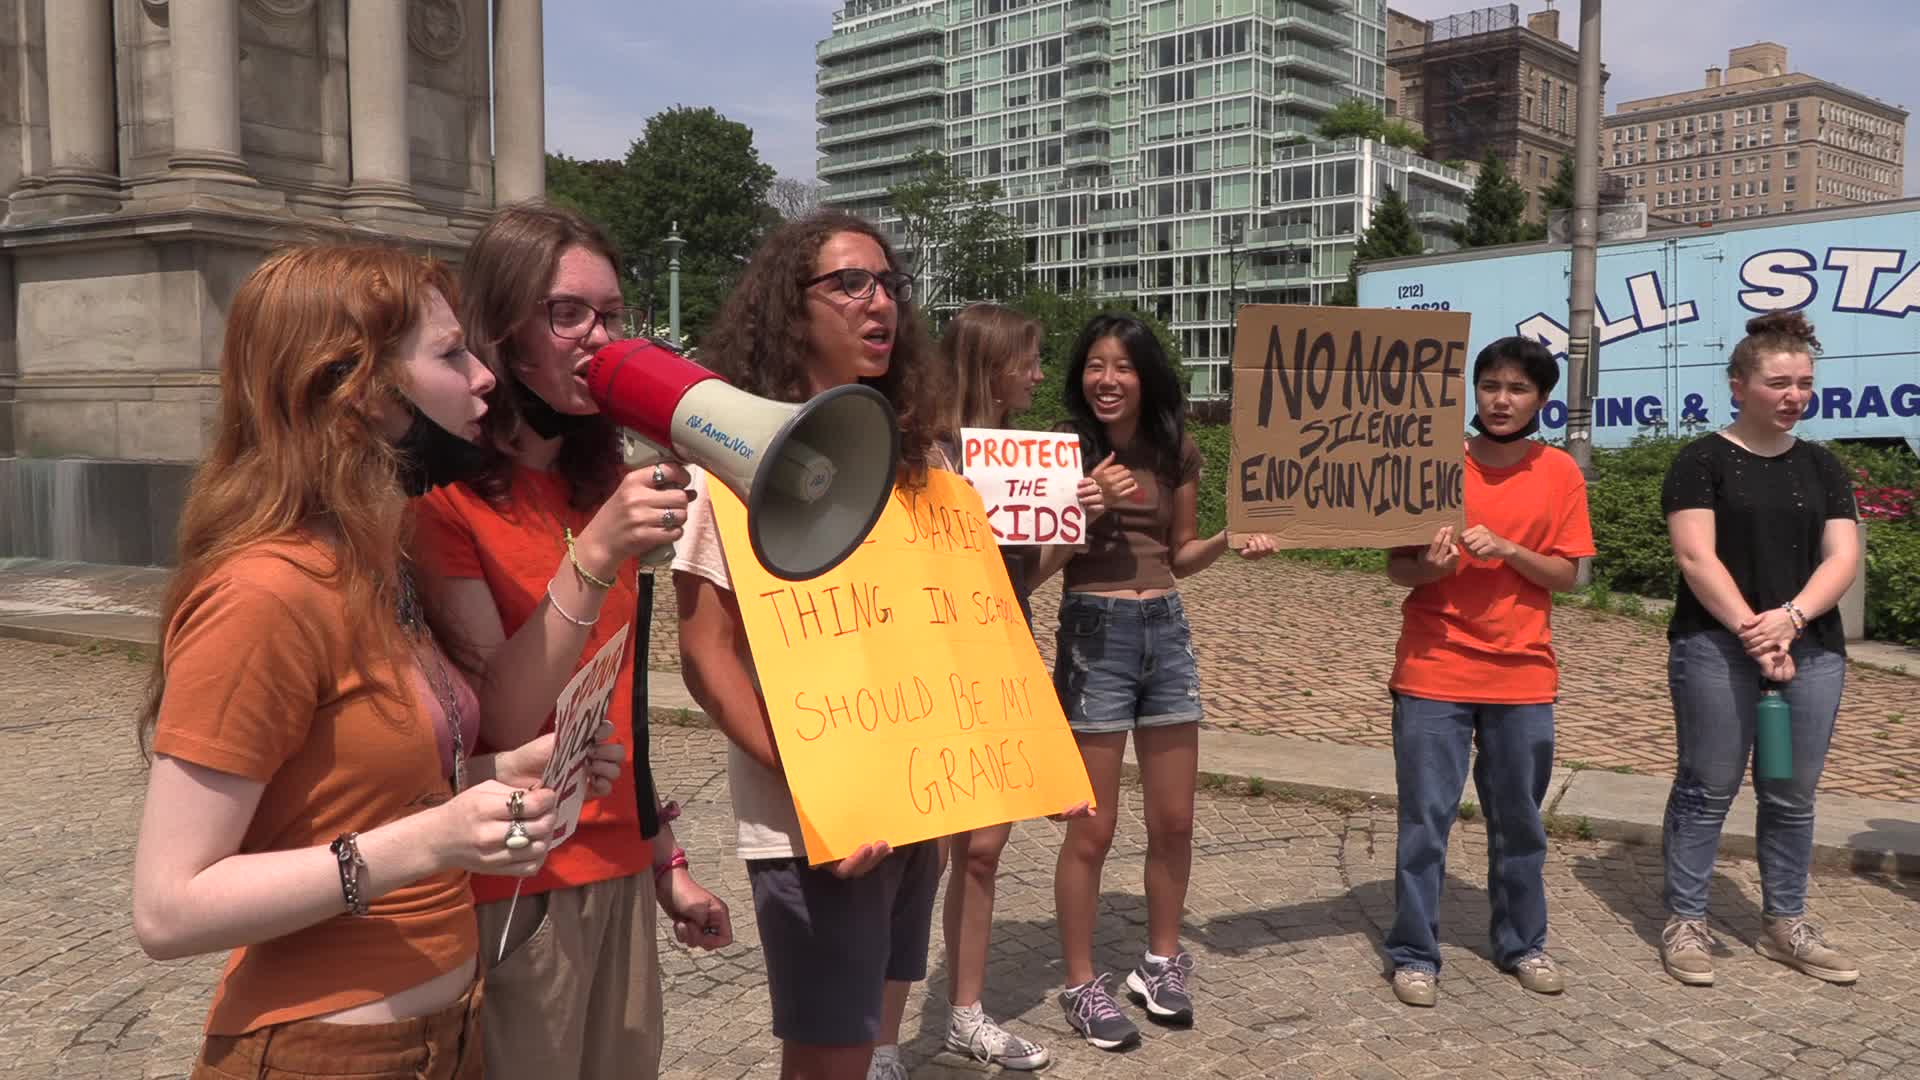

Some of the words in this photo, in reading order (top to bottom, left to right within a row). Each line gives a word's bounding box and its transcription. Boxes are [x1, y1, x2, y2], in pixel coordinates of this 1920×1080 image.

[1257, 325, 1336, 428] NO
[1343, 330, 1465, 411] MORE
[1300, 410, 1434, 459] SILENCE
[1536, 395, 1663, 428] OING
[1681, 393, 1710, 424] &
[965, 438, 1082, 468] PROTECT
[1241, 453, 1303, 502] END
[1304, 456, 1355, 509] GUN
[1357, 452, 1464, 517] VIOLENCE
[1005, 478, 1048, 497] THE
[760, 582, 893, 648] THING
[922, 587, 958, 624] IN
[795, 676, 933, 741] SHOULD
[949, 673, 989, 730] BE
[1001, 676, 1033, 721] MY
[908, 738, 1034, 815] GRADES
